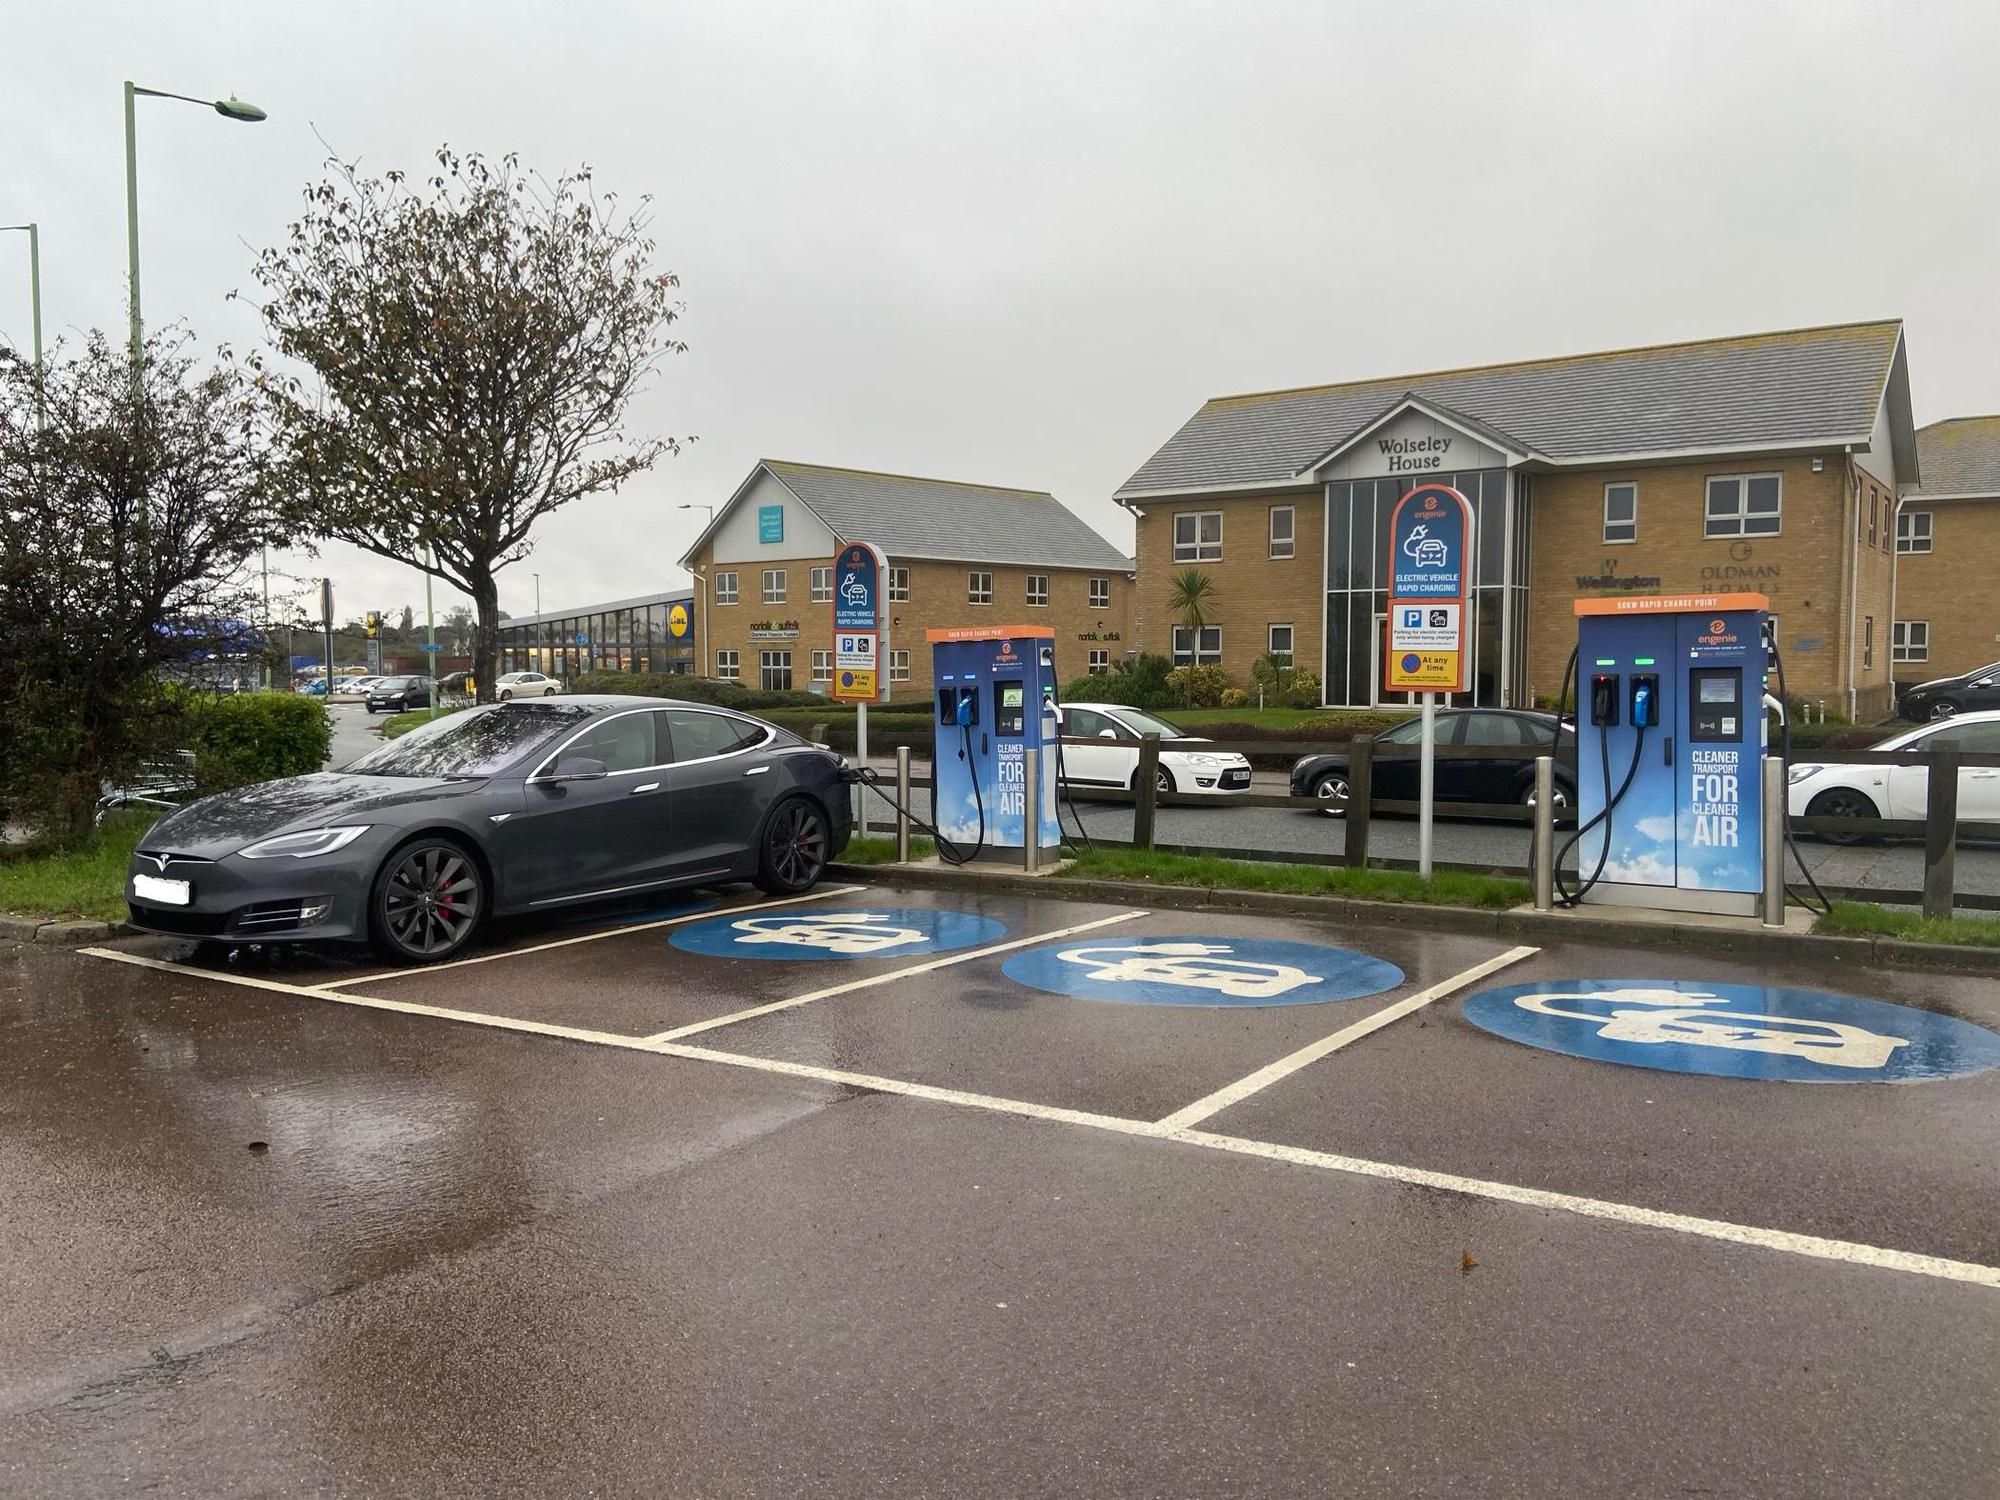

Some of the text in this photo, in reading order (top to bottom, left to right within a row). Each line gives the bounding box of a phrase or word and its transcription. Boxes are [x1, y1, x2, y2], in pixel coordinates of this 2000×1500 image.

[1378, 436, 1452, 454] Wolseley
[1388, 455, 1441, 471] House
[1396, 573, 1459, 582] ELECTRIC VEHICLE
[1700, 565, 1781, 580] OLDMAN
[1397, 583, 1456, 592] RAPID CHARGING
[1576, 575, 1661, 590] Wellington
[1702, 582, 1780, 595] HOMES
[1639, 600, 1662, 609] RAPID
[1663, 599, 1692, 608] CHARGE
[1694, 598, 1718, 607] POINT
[1408, 612, 1420, 626] P
[1698, 634, 1738, 645] engenie
[1422, 656, 1449, 665] At any
[997, 744, 1024, 753] CLEANER
[1692, 750, 1738, 763] CLEANER
[998, 761, 1025, 782] FOR
[1692, 763, 1738, 774] TRANSPORT
[998, 783, 1025, 792] CLEANER
[1692, 774, 1738, 802] FOR
[1000, 792, 1025, 815] AIR
[1692, 802, 1738, 816] CLEANER
[1692, 815, 1739, 847] AIR
